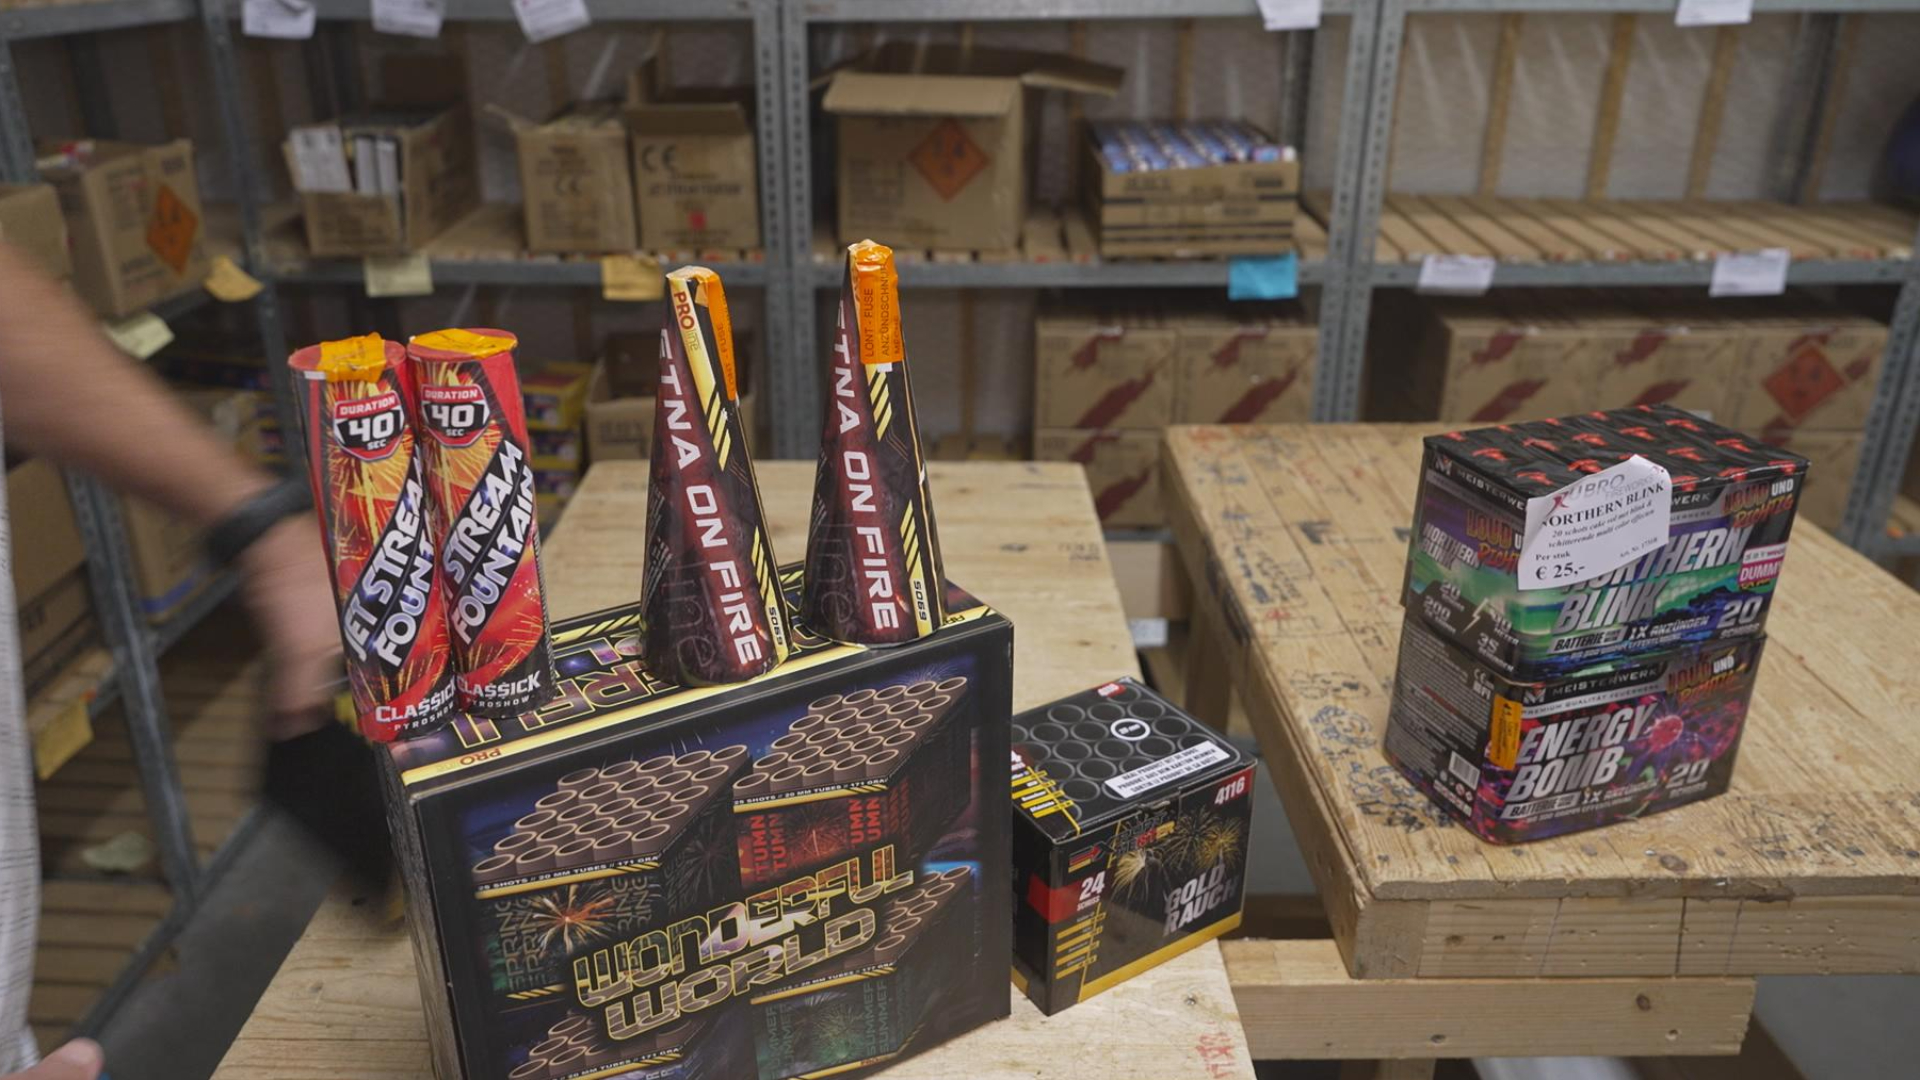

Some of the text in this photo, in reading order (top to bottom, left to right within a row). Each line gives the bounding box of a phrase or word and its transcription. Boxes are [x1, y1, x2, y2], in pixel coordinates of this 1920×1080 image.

[863, 288, 874, 358] LONT FUSE
[340, 397, 396, 415] DURATION
[424, 389, 478, 400] DURATION
[349, 411, 395, 441] 40
[431, 403, 475, 427] 40
[366, 438, 387, 450] SEC
[445, 428, 464, 437] SEC
[843, 450, 877, 513] ON
[1456, 470, 1527, 511] MEISTERWE
[1626, 480, 1665, 506] BLINK
[1771, 478, 1795, 497] UND
[442, 440, 522, 584] STREAM
[1552, 530, 1563, 538] 20
[1564, 525, 1589, 536] schots
[1590, 520, 1606, 530] cake
[1422, 522, 1481, 571] NORTHERN
[1535, 551, 1571, 562] Per stuk
[1561, 524, 1755, 594] THERN
[376, 508, 436, 668] FOUNT
[686, 484, 728, 548] ON
[710, 560, 762, 665] FIRE
[856, 526, 900, 630] FIRE
[1535, 562, 1586, 581] € 25,-
[1551, 578, 1671, 635] BLINK
[1717, 595, 1764, 629] 20
[344, 593, 378, 662] JET
[1553, 631, 1605, 652] BATTERIE
[1628, 624, 1650, 641] 1X
[1713, 654, 1735, 675] UND
[1551, 669, 1660, 696] MEISTERWERK
[1516, 701, 1659, 765] ENERGY
[1504, 746, 1625, 804] BOMB
[1665, 757, 1711, 790] 20
[746, 794, 776, 804] SHOTS
[796, 788, 812, 796] MM
[813, 784, 842, 793] TUBES
[1213, 776, 1246, 805] 4116
[1509, 797, 1557, 817] BATTERIE
[849, 799, 864, 844] UMN
[866, 797, 882, 841] UMN
[768, 814, 788, 873] TUMN
[492, 877, 529, 889] SHOTS
[553, 869, 571, 878] MM
[573, 864, 607, 875] TUBES
[617, 859, 635, 868] 171
[1079, 871, 1106, 901] 24
[1165, 863, 1226, 914] GOLD
[1163, 874, 1241, 937] RAUCH
[573, 844, 914, 1007] WONDERFUL
[605, 907, 876, 1040] WORLD
[600, 1059, 631, 1070] TUBES
